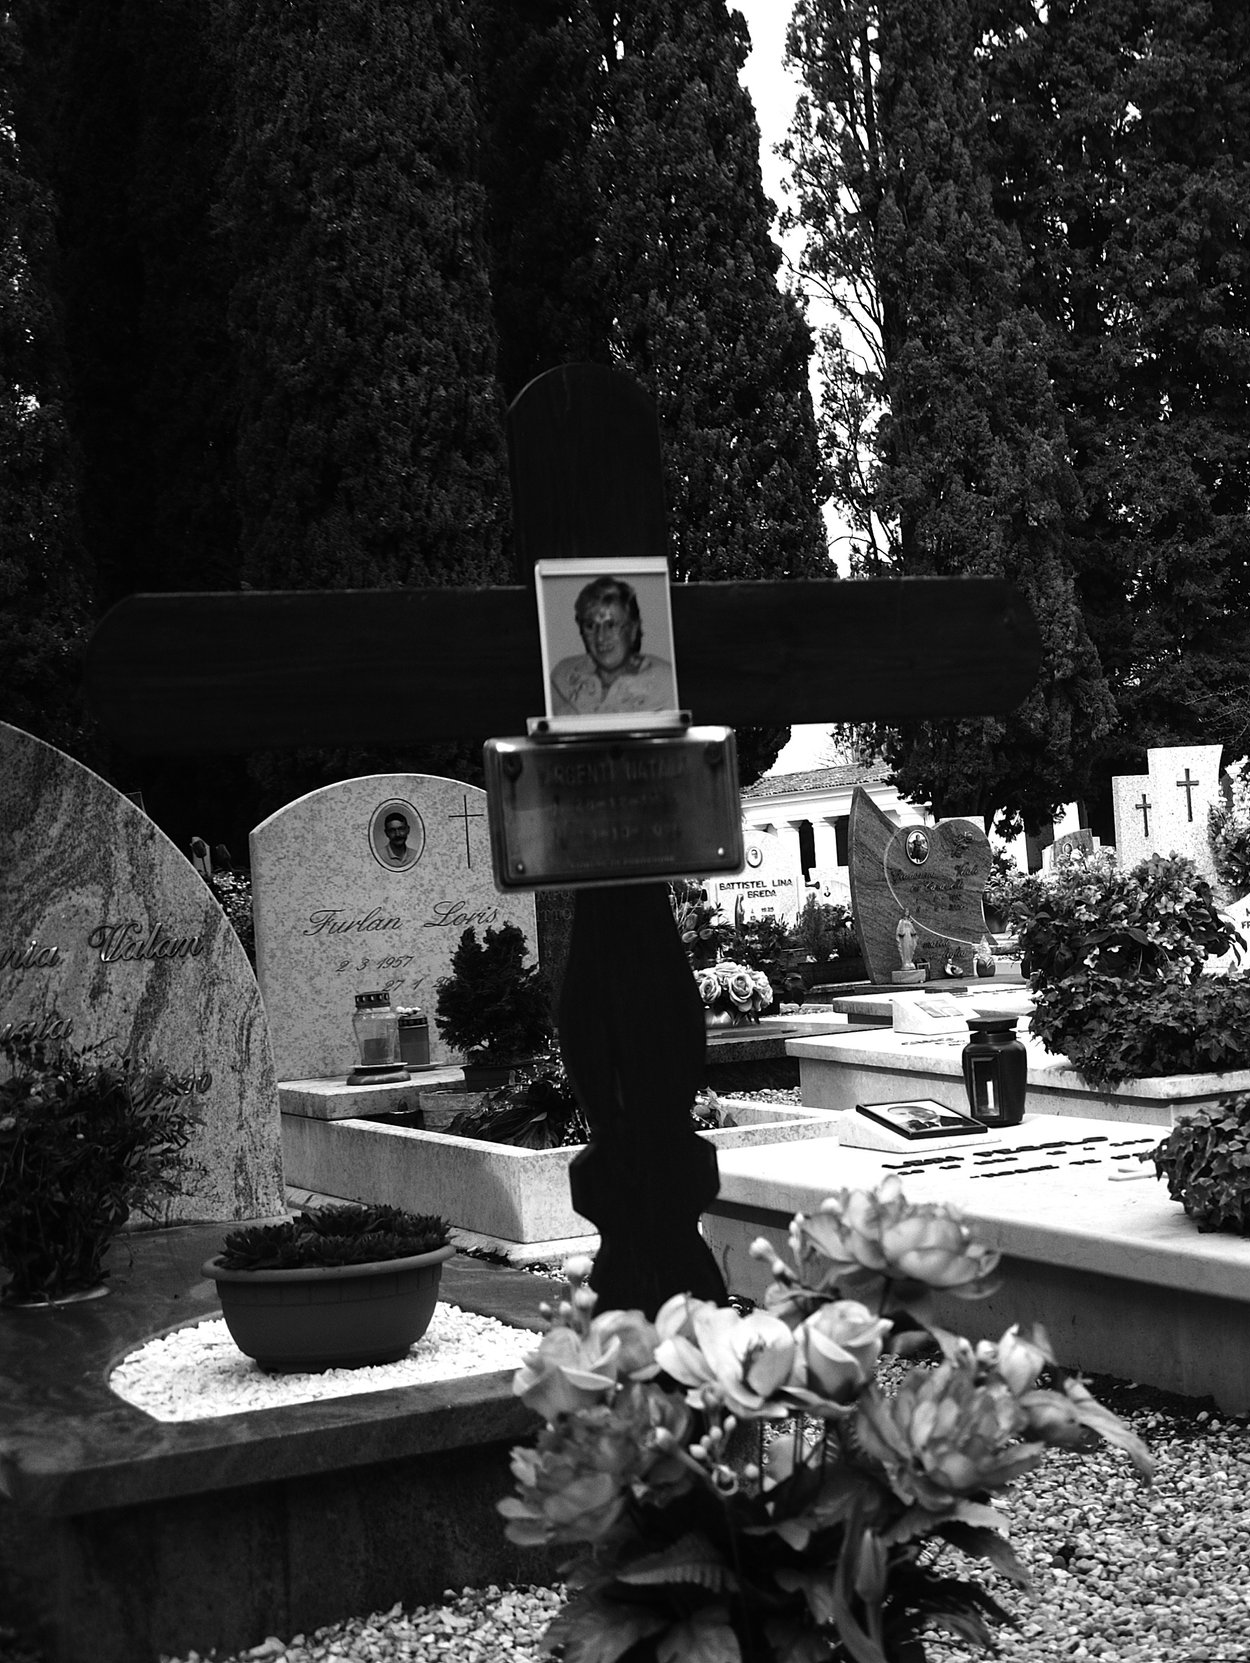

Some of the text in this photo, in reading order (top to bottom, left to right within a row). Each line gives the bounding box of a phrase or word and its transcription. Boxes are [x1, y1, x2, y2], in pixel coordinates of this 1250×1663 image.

[719, 879, 793, 890] BATTISTEL LINA
[303, 901, 499, 936] Furlan Loris
[88, 922, 205, 963] Valan
[336, 956, 414, 972] 2 3 1957
[382, 979, 404, 992] 27
